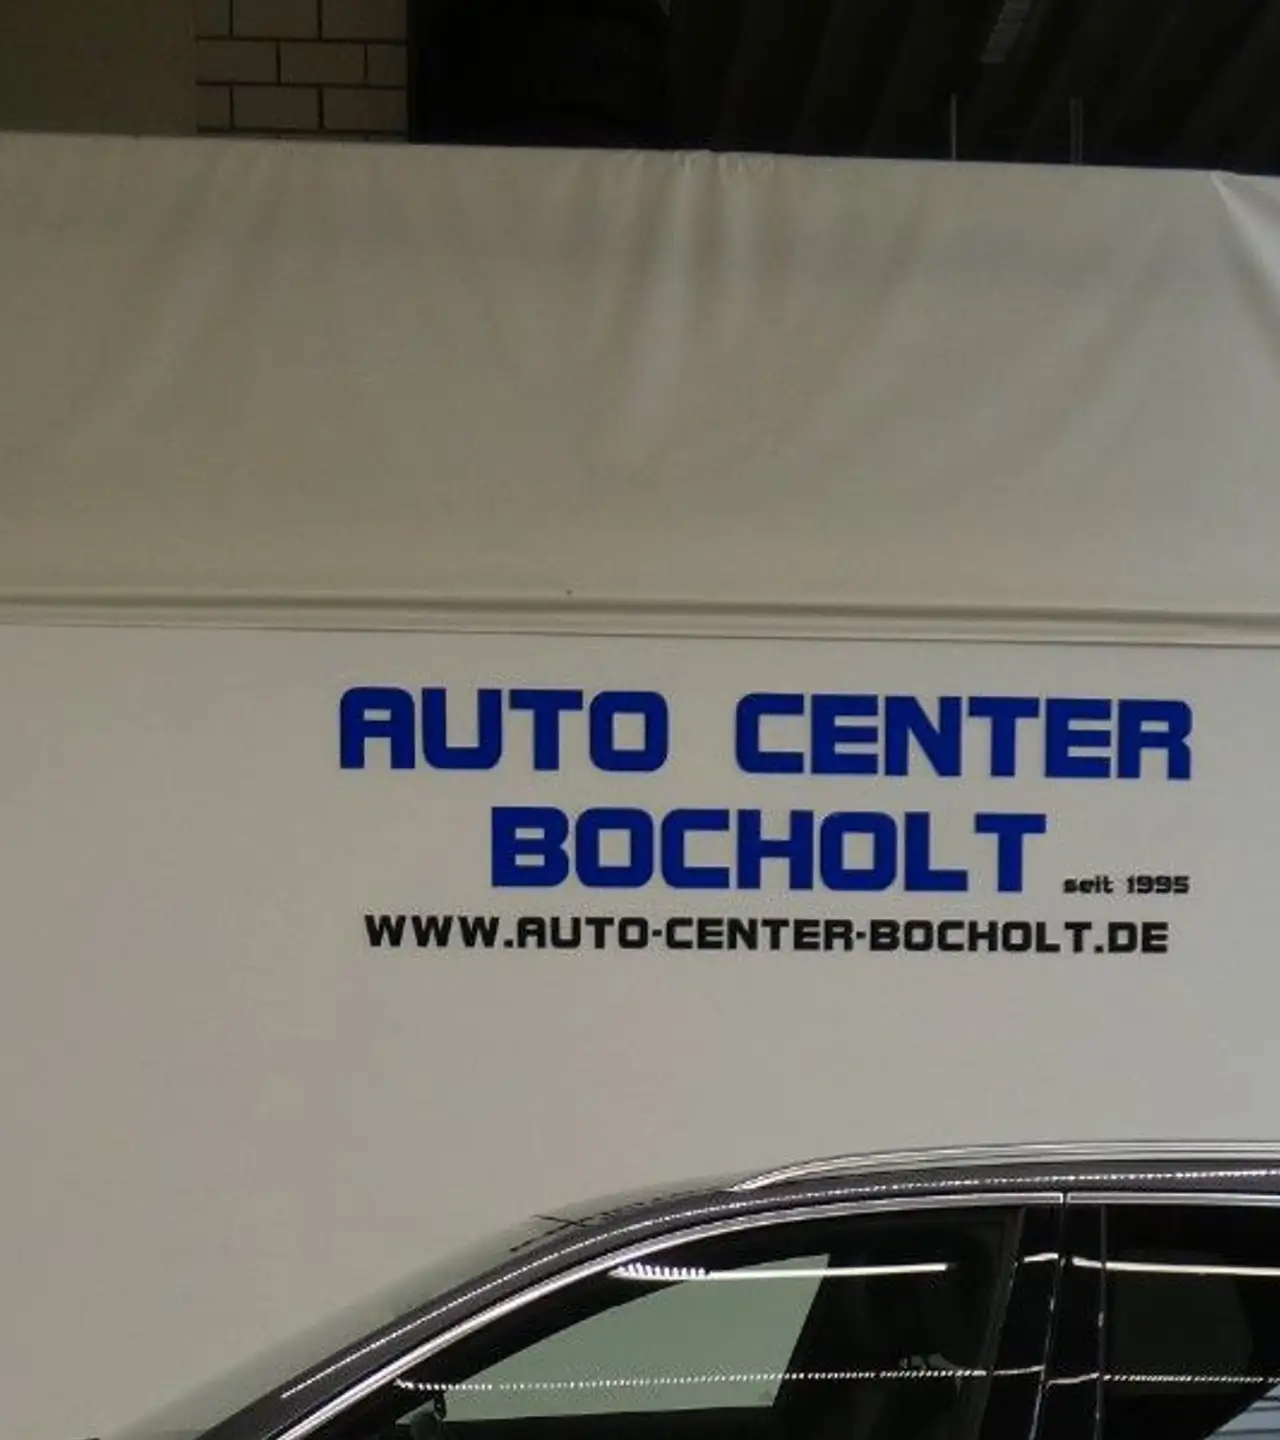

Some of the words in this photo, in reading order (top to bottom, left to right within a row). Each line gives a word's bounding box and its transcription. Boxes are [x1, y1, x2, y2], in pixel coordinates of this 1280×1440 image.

[338, 686, 670, 774] AUTO
[735, 692, 1193, 781] CENTER
[489, 805, 1048, 894] BOCHOLT
[1062, 874, 1115, 895] seit
[1126, 874, 1191, 896] 1995
[363, 913, 1170, 955] WWW.AUTO-CENTER-BOCHOLT.DE
